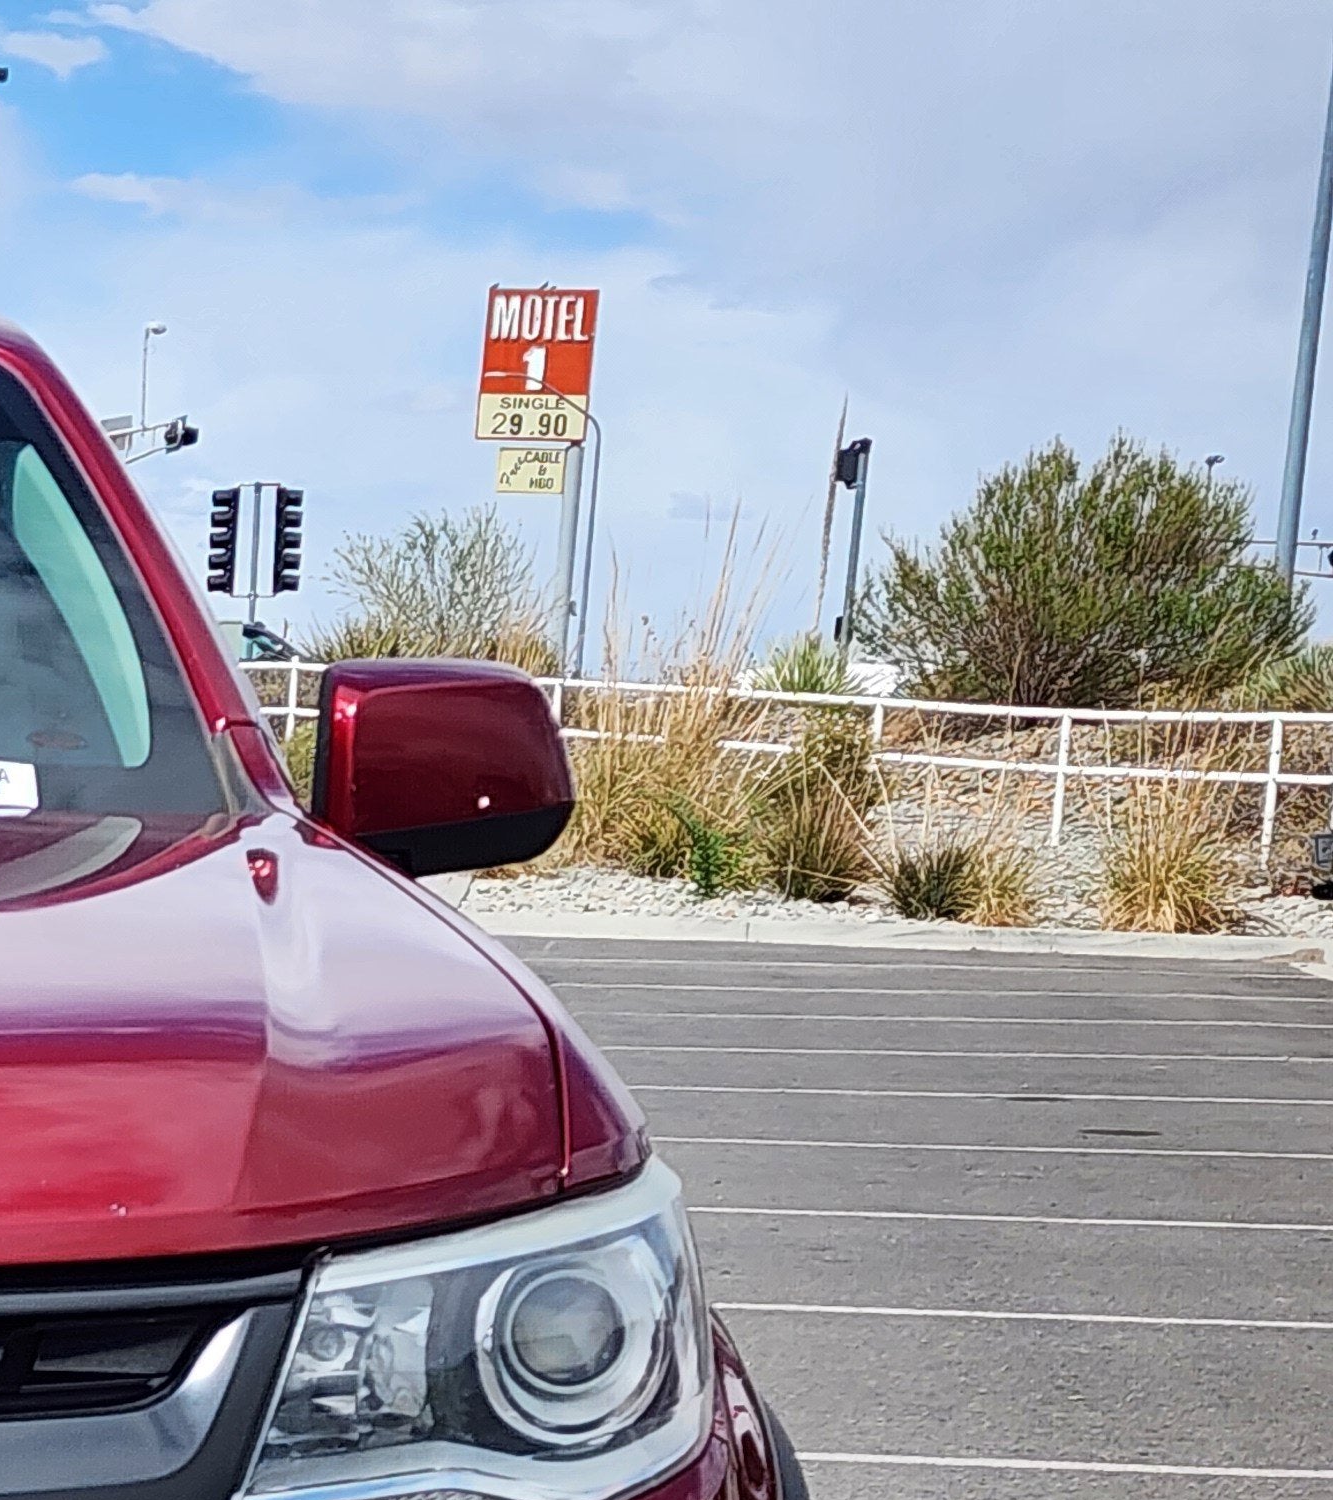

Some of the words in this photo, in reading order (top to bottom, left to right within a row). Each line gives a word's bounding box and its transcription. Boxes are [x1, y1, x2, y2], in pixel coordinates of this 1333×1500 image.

[490, 294, 590, 342] MOTEL
[522, 345, 547, 392] 1
[499, 397, 567, 410] SINGLE
[491, 412, 568, 437] 29.90
